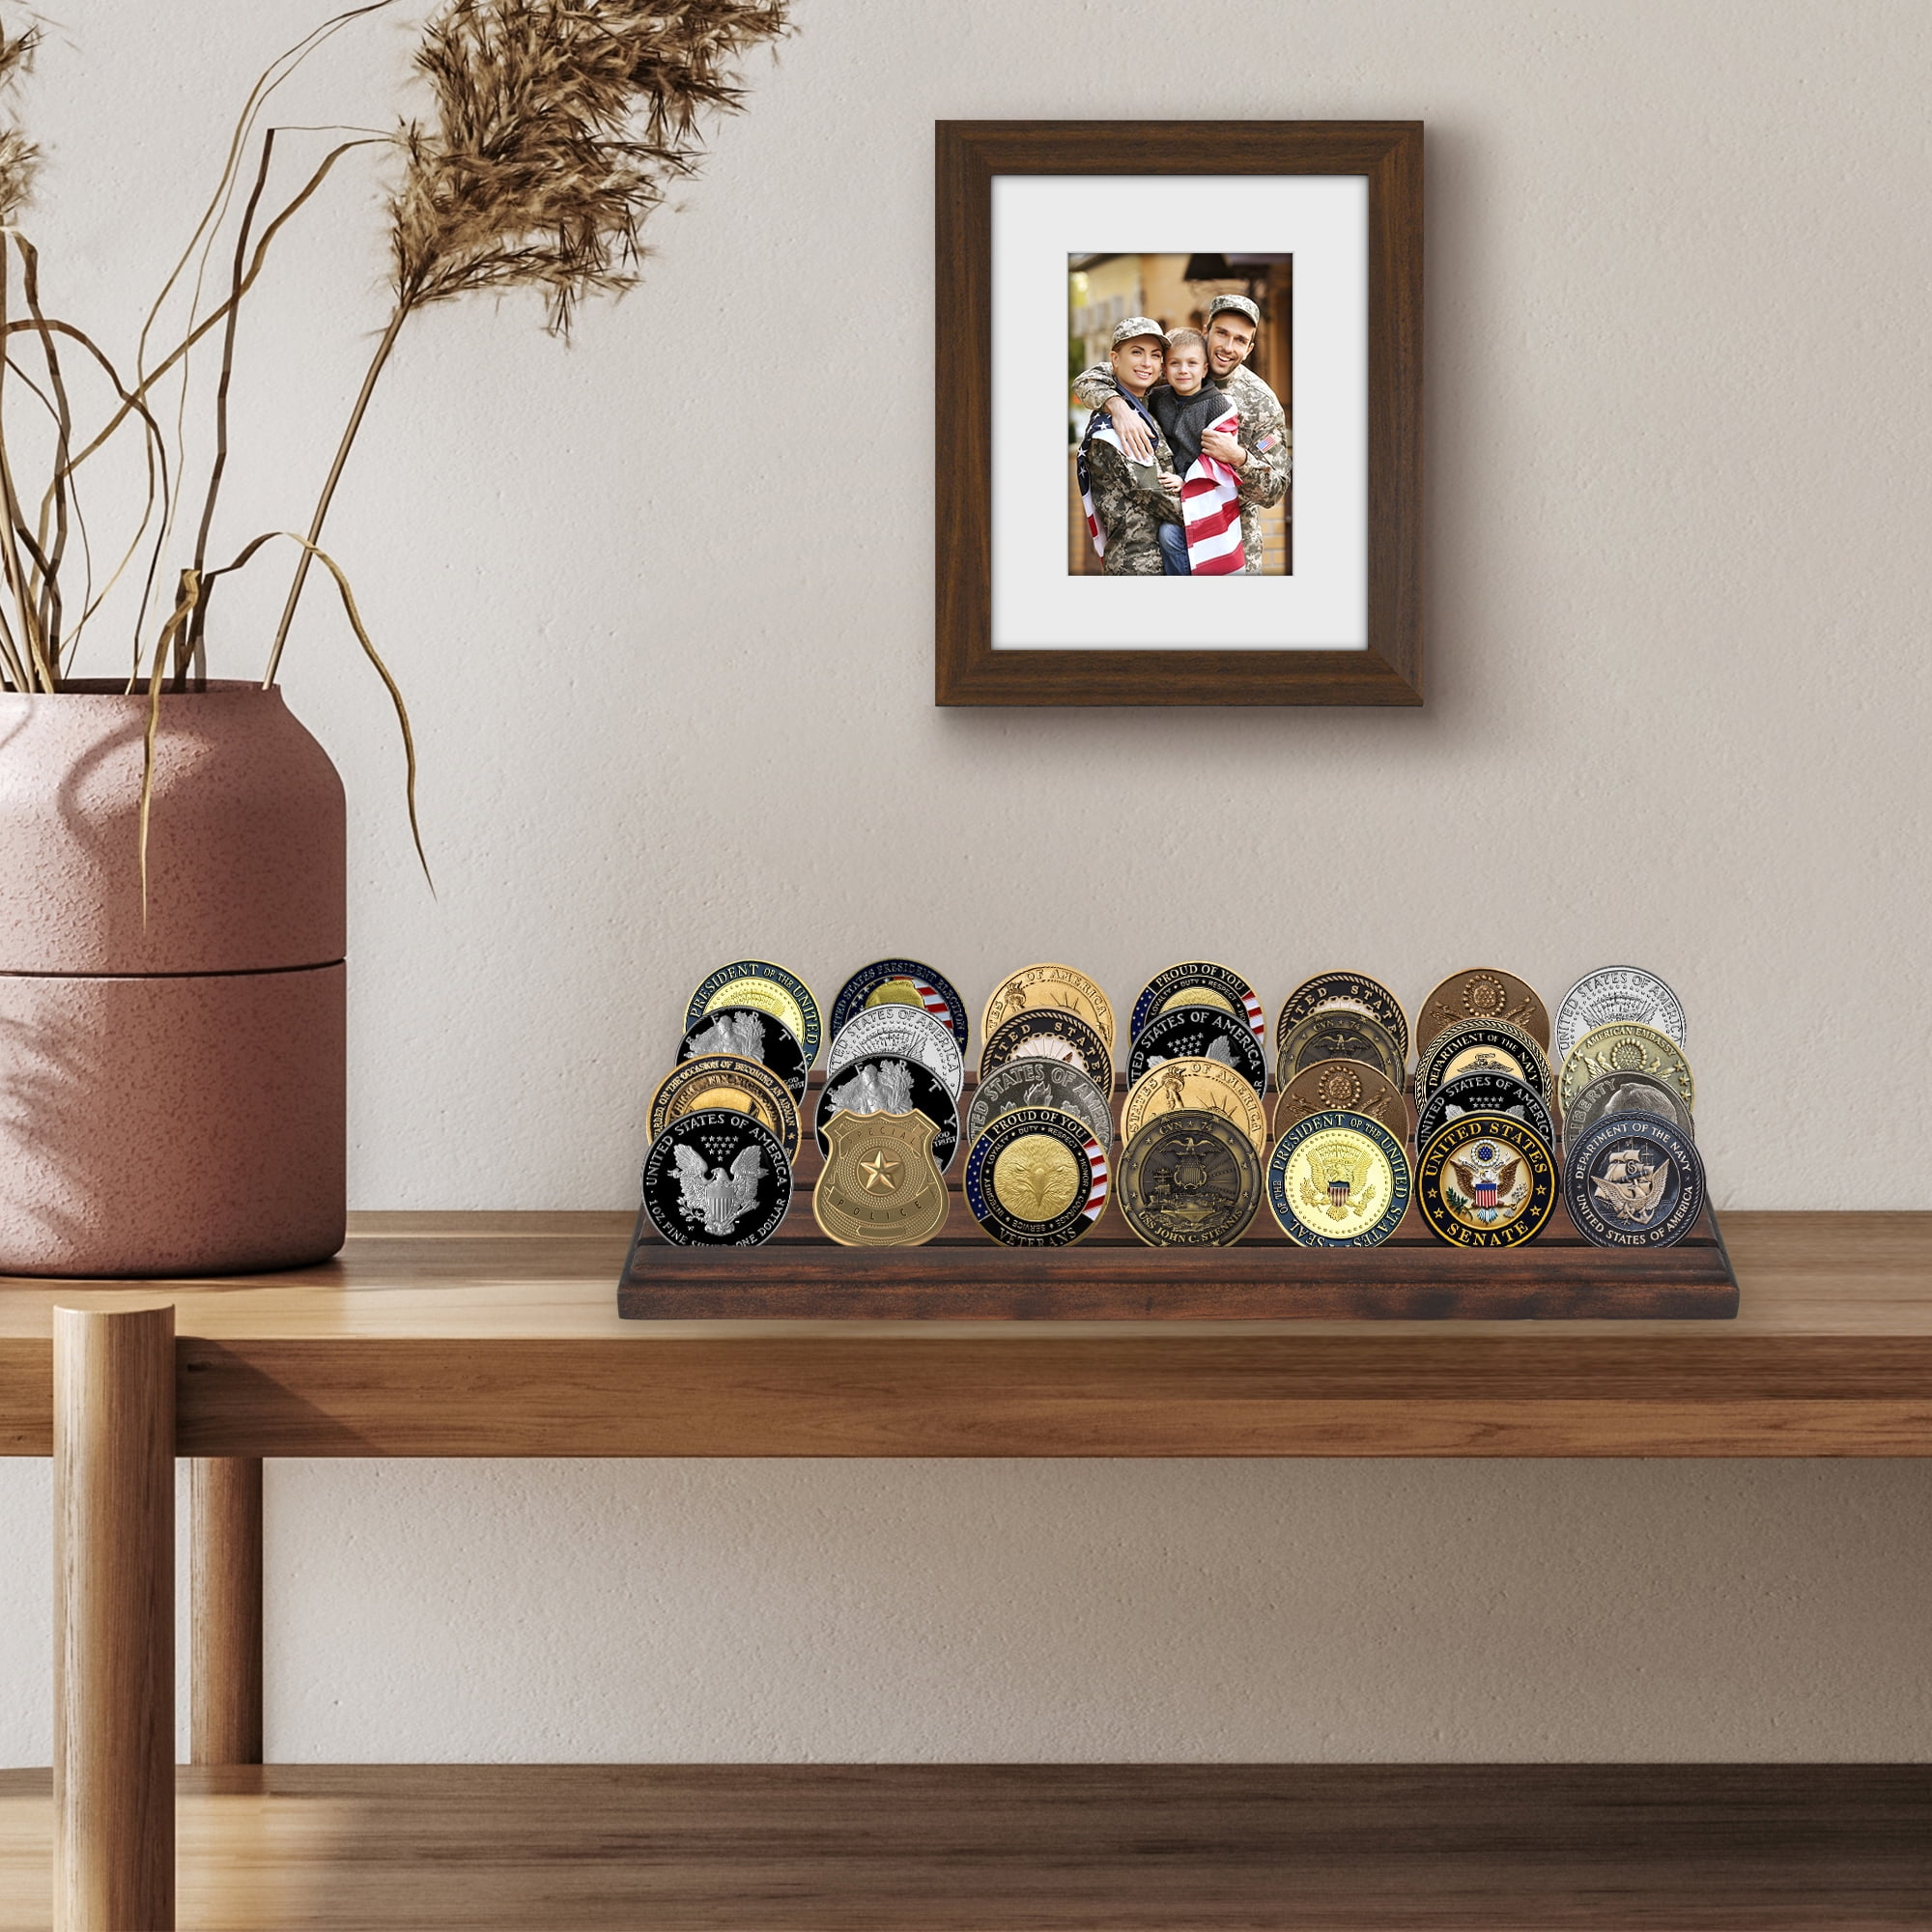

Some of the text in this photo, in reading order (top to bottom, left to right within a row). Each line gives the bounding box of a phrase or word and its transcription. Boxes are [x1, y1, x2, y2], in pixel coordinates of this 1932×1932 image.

[843, 969, 875, 999] STATES
[877, 963, 937, 982] PRESIDENT
[936, 981, 965, 1031] ELECTION
[1026, 969, 1044, 981] OF
[1050, 969, 1108, 1017] AMERICA
[1151, 979, 1236, 1015] LOYALTY DUTY RESPECT
[1157, 964, 1245, 990] PROUD OF YOU
[690, 964, 819, 1045] PRESIDENT OF THE UNITED
[1313, 1020, 1334, 1033] CVN
[1350, 985, 1398, 1036] STATE
[1560, 999, 1579, 1050] UNITED
[1577, 973, 1628, 998] STATES
[1632, 975, 1651, 988] OF
[847, 1009, 895, 1037] STATES
[898, 1009, 919, 1021] OF
[918, 1015, 959, 1072] AMERICA
[1054, 1022, 1102, 1083] STATES
[1141, 1011, 1185, 1048] STATES
[1190, 1011, 1209, 1023] OF
[1211, 1016, 1261, 1070] AMERICA
[1429, 1033, 1486, 1086] DEPARTMENT
[1501, 1038, 1519, 1052] THE
[1518, 1052, 1539, 1082] NAVY
[1586, 1027, 1677, 1057] AMERICAN EMBASSY
[667, 1076, 683, 1093] THE
[681, 1061, 720, 1079] OCCASION
[734, 1063, 774, 1087] BECOMING
[984, 1065, 1045, 1101] STATES
[1051, 1067, 1077, 1087] OF
[1129, 1063, 1262, 1133] STATES OF AMERICA
[1446, 1077, 1492, 1096] STATES
[1495, 1078, 1513, 1091] OF
[846, 1126, 916, 1145] SPECIAL
[992, 1110, 1086, 1138] PROUD OF YOU
[1159, 1122, 1182, 1135] CVN
[646, 1114, 788, 1187] UNITED STATES OF AMERICA
[1425, 1122, 1548, 1177] UNITED STATES
[1576, 1122, 1691, 1179] DEPARTMENT OF THE NAVY
[983, 1125, 1090, 1233] LOYALTY DUTY RESPECT HONOR COURAGE SERVICE INTEGRITY
[1272, 1114, 1407, 1247] PRESIDENT OF THE UNITED STATES
[663, 1221, 689, 1245] FINE
[735, 1198, 786, 1246] ONE DOLLAR
[838, 1199, 923, 1220] POLICE
[1138, 1209, 1243, 1243] USS JOHN C. STENNIS
[1272, 1180, 1326, 1247] SEAL OF THE
[1447, 1220, 1529, 1246] SENATE
[1577, 1185, 1693, 1244] UNITED STATES OF AMERICA
[999, 1227, 1077, 1247] VETERANS
